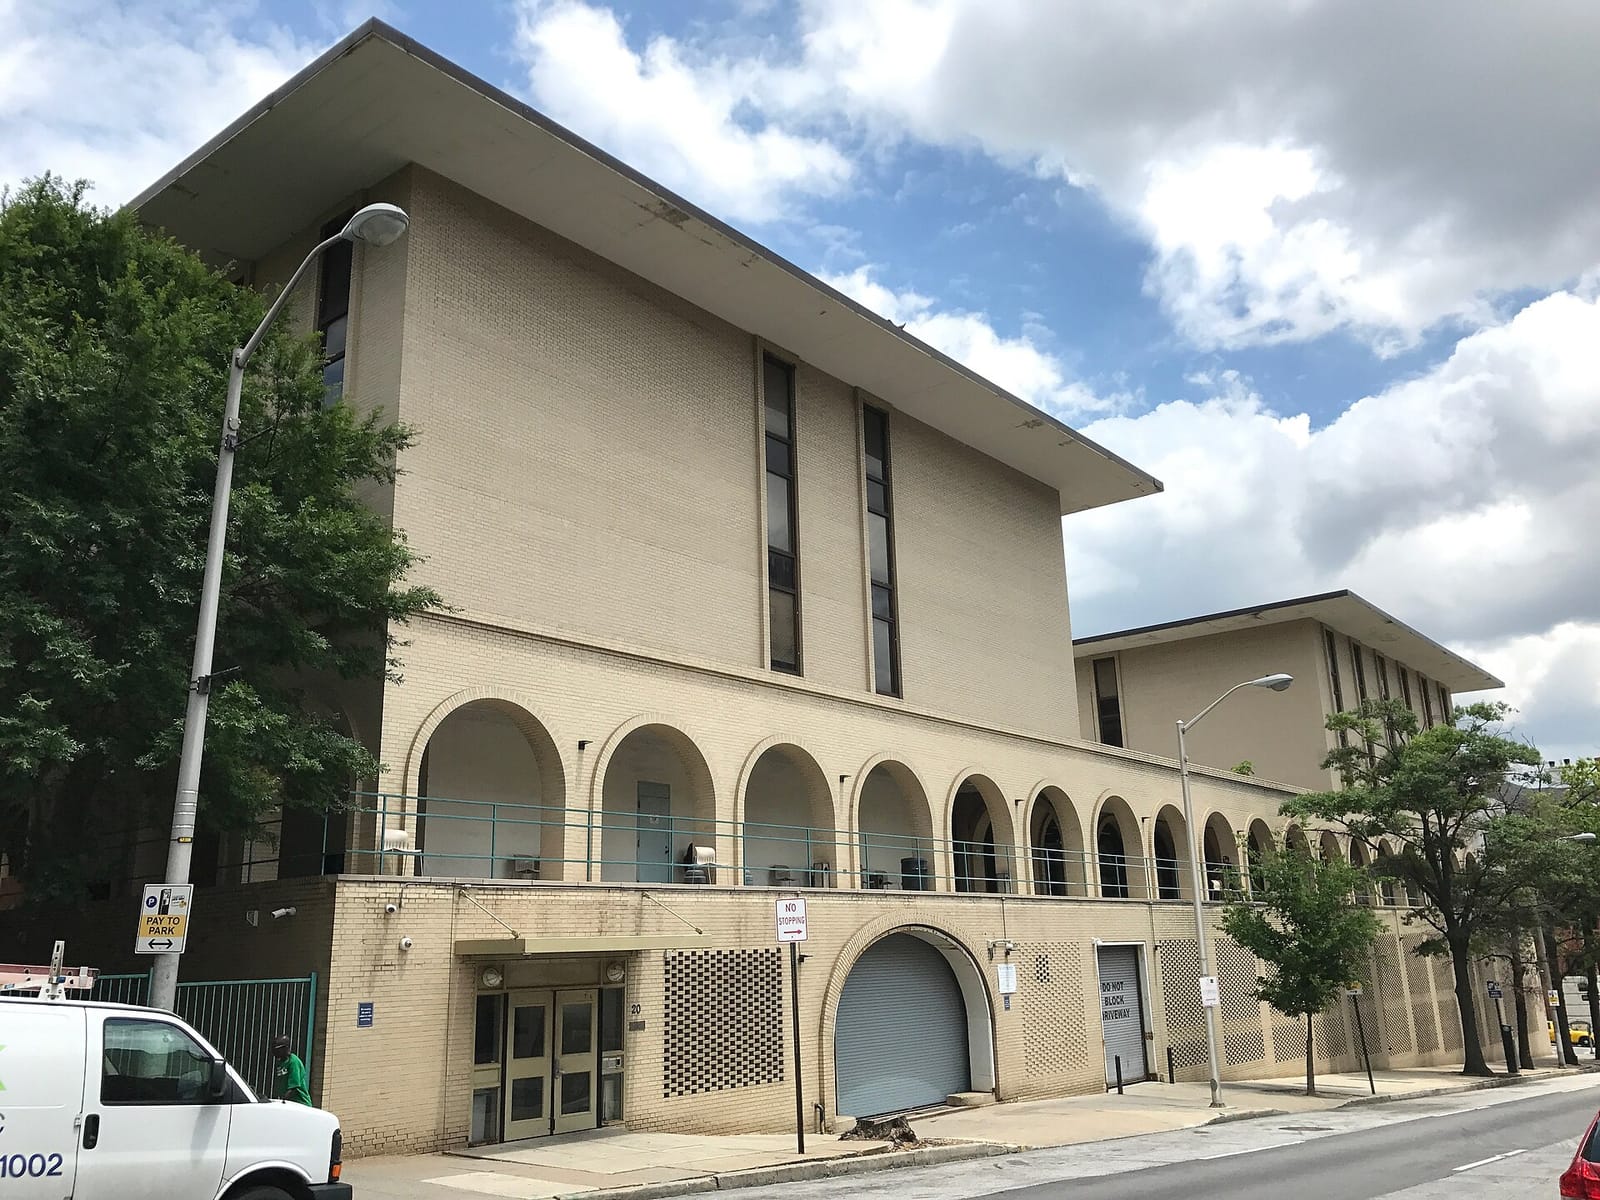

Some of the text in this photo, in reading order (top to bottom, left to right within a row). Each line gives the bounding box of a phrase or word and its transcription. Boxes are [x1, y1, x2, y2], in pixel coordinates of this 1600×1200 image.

[785, 903, 797, 912] NO
[146, 916, 180, 925] PAY TO
[779, 916, 805, 925] STOPPING
[148, 926, 175, 935] PARK
[1102, 981, 1124, 992] DO NOT
[1104, 995, 1125, 1006] BLOCK
[631, 1003, 641, 1015] 20
[0, 1153, 63, 1178] 1002
